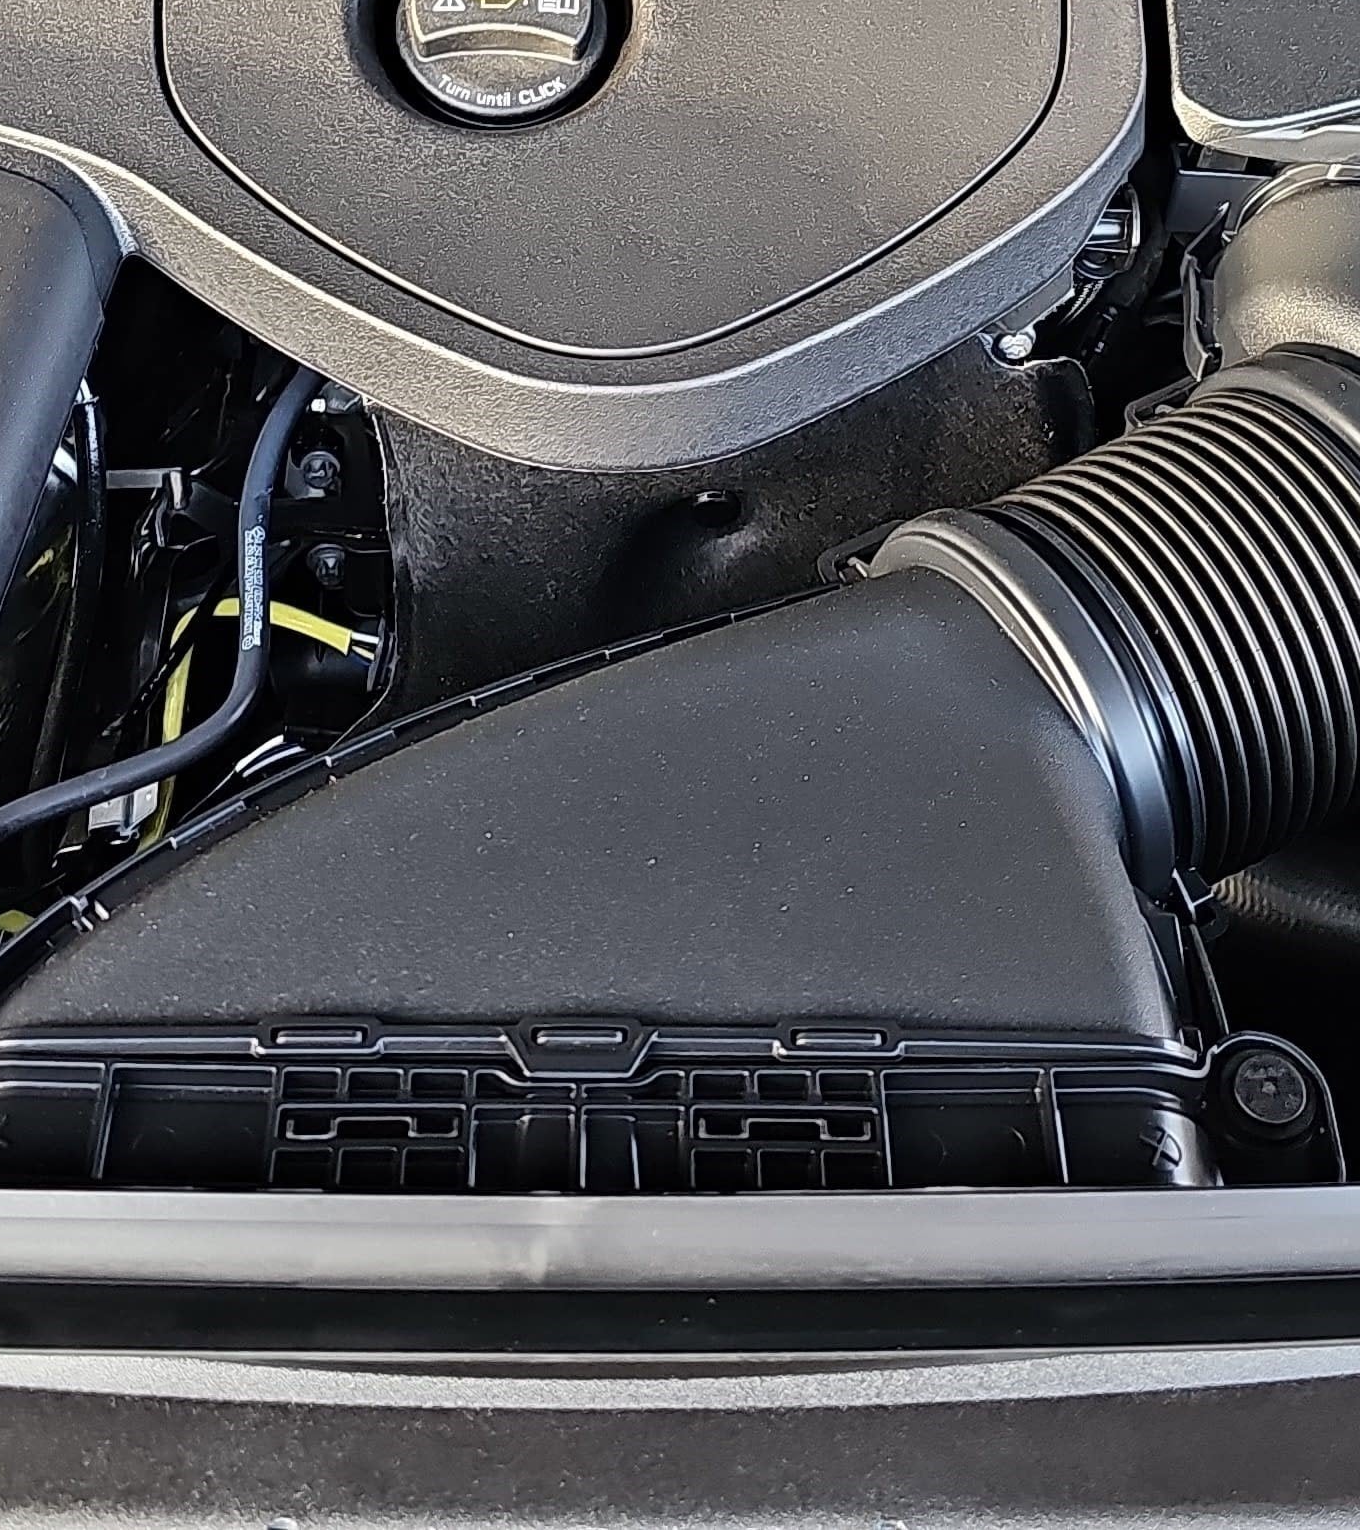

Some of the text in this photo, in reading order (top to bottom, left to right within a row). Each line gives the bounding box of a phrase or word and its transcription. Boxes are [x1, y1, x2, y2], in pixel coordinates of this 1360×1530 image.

[438, 74, 567, 107] Turn until CLICK
